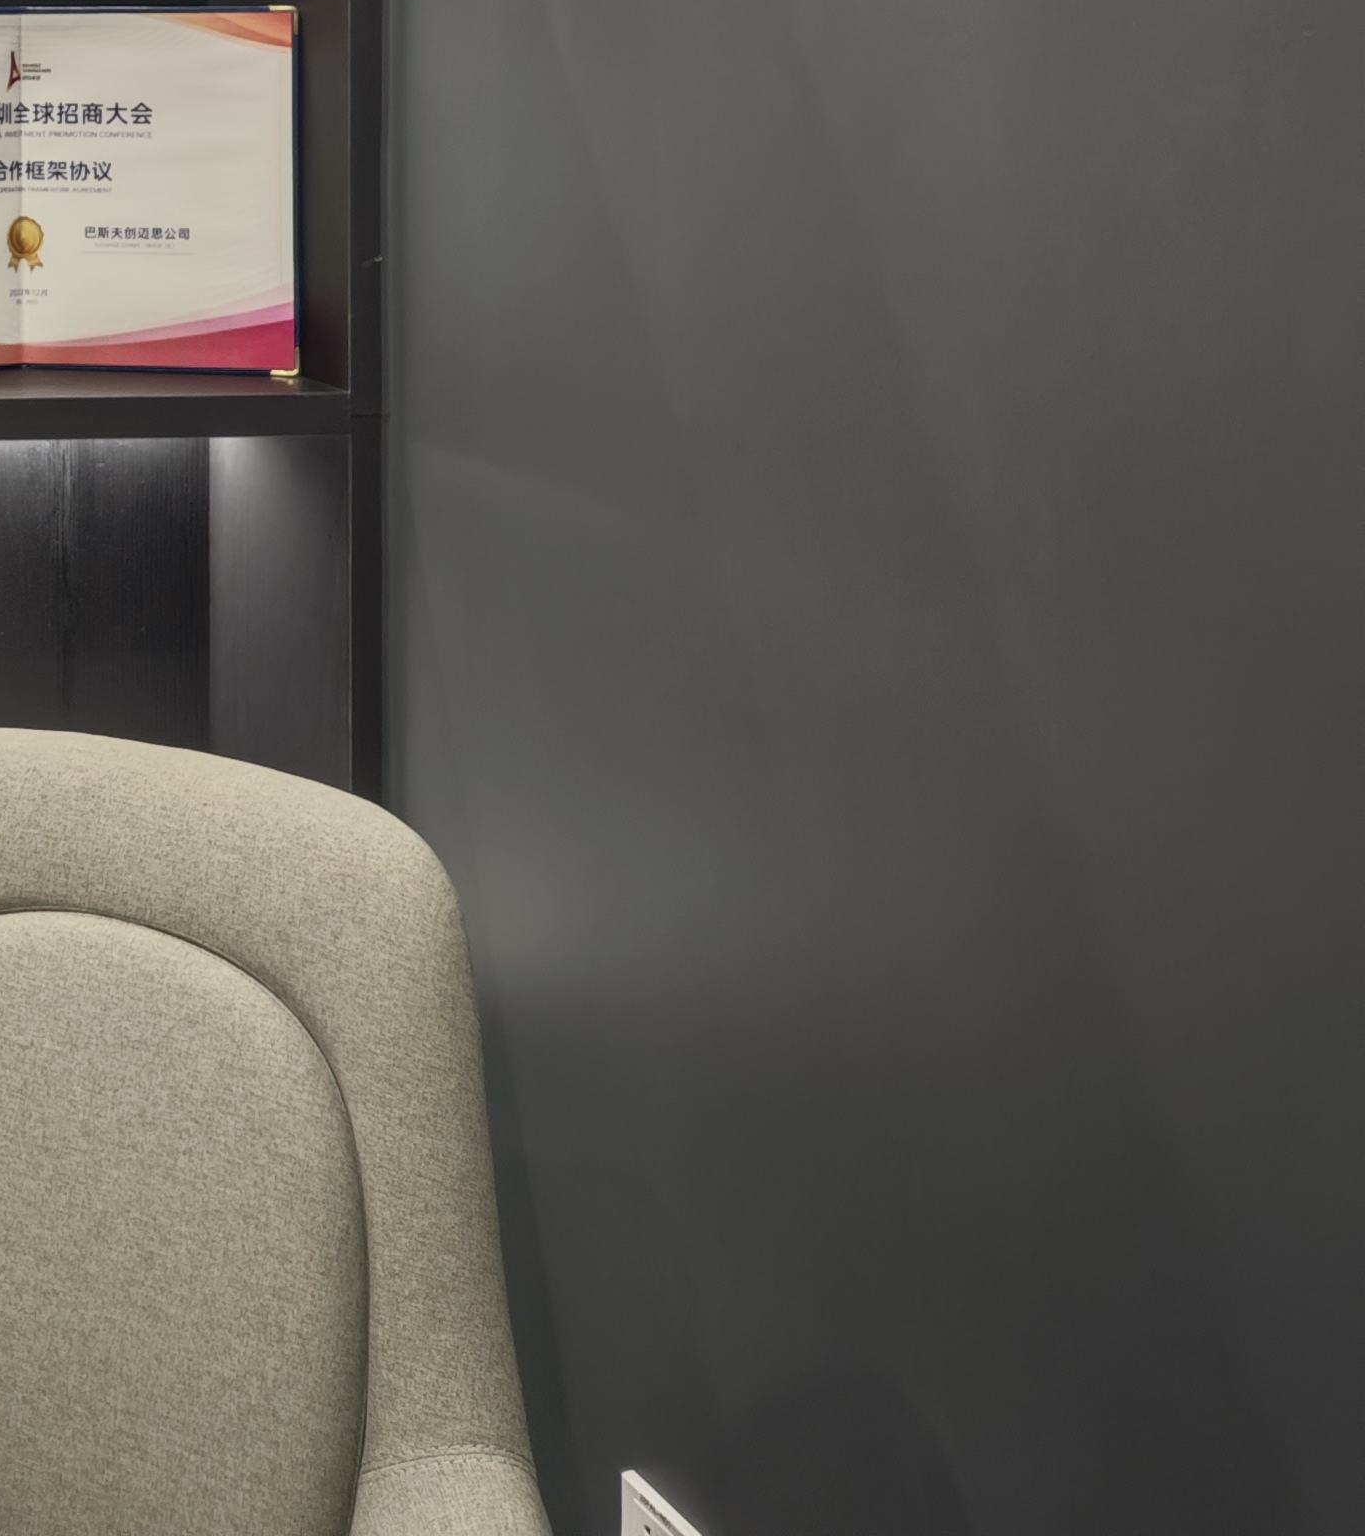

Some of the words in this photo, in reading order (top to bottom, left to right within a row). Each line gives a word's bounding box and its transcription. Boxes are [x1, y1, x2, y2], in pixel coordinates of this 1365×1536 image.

[84, 226, 190, 240] 巴斯夫创迈思公司
